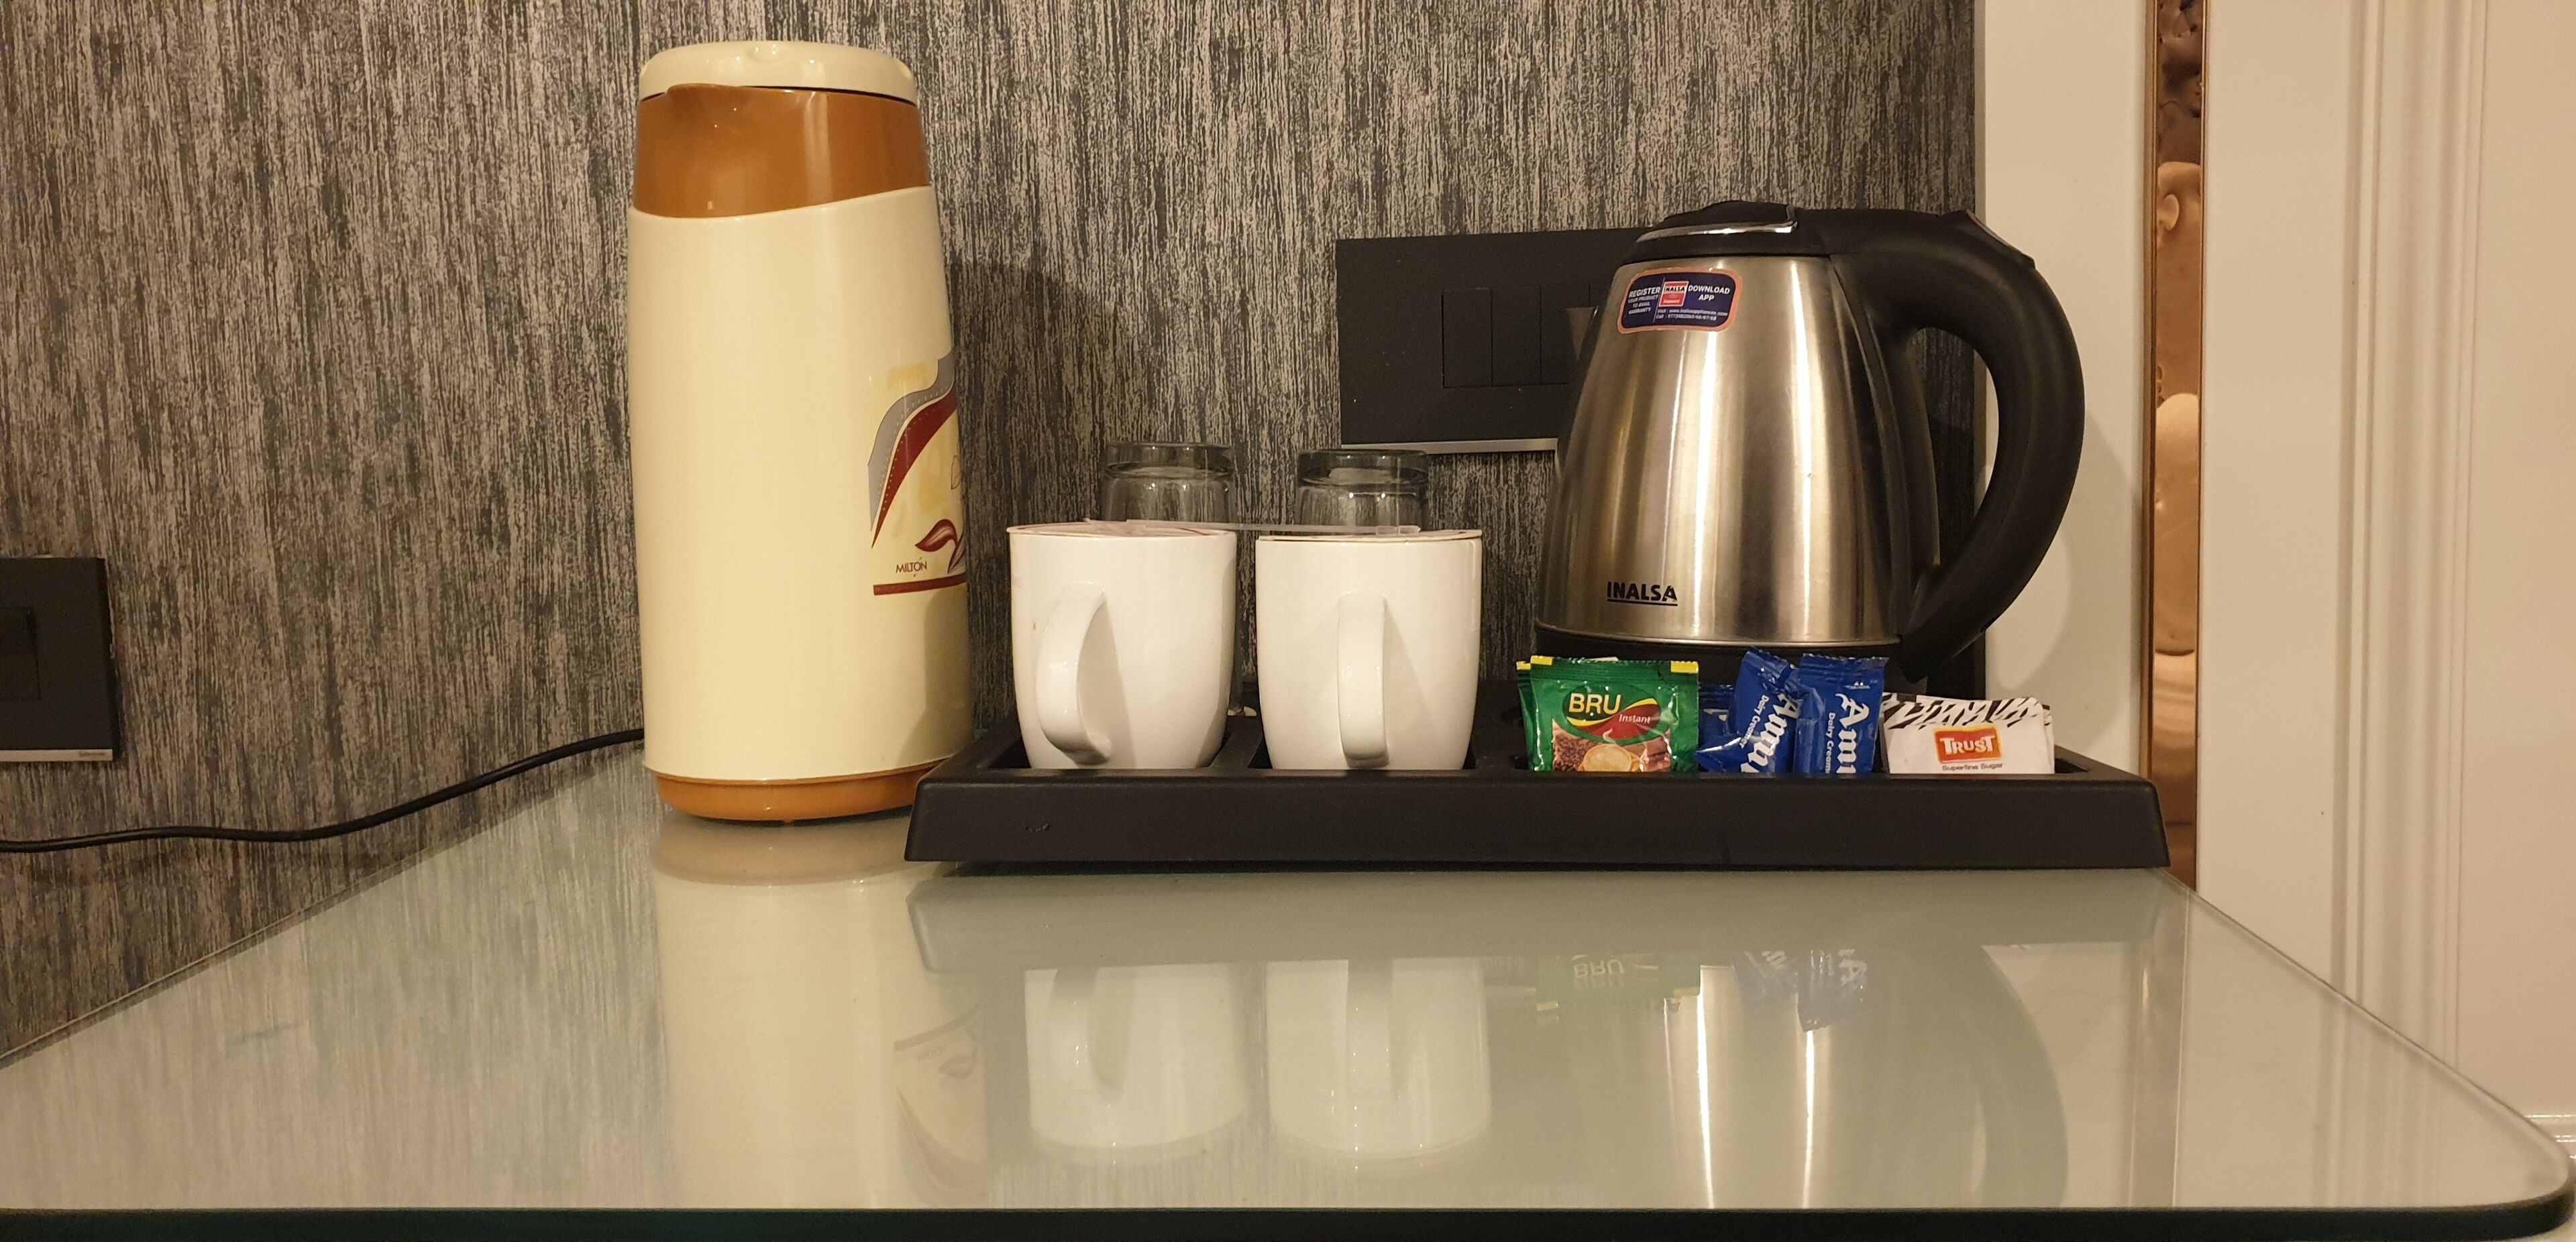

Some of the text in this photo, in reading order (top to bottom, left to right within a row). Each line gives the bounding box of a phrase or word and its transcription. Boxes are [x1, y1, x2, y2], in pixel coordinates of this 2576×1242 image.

[1629, 286, 1661, 298] REGISTER
[1688, 284, 1730, 294] DOWNLOAD
[896, 560, 928, 573] MILTON
[1607, 581, 1678, 602] INALSA
[1568, 693, 1621, 714] BRU
[1619, 714, 1651, 724] Instant
[1739, 695, 1770, 748] Dairy Creamer
[1826, 712, 1836, 738] Dairy
[1939, 735, 1996, 755] TRUST
[1942, 763, 2003, 772] Superfine Sugar
